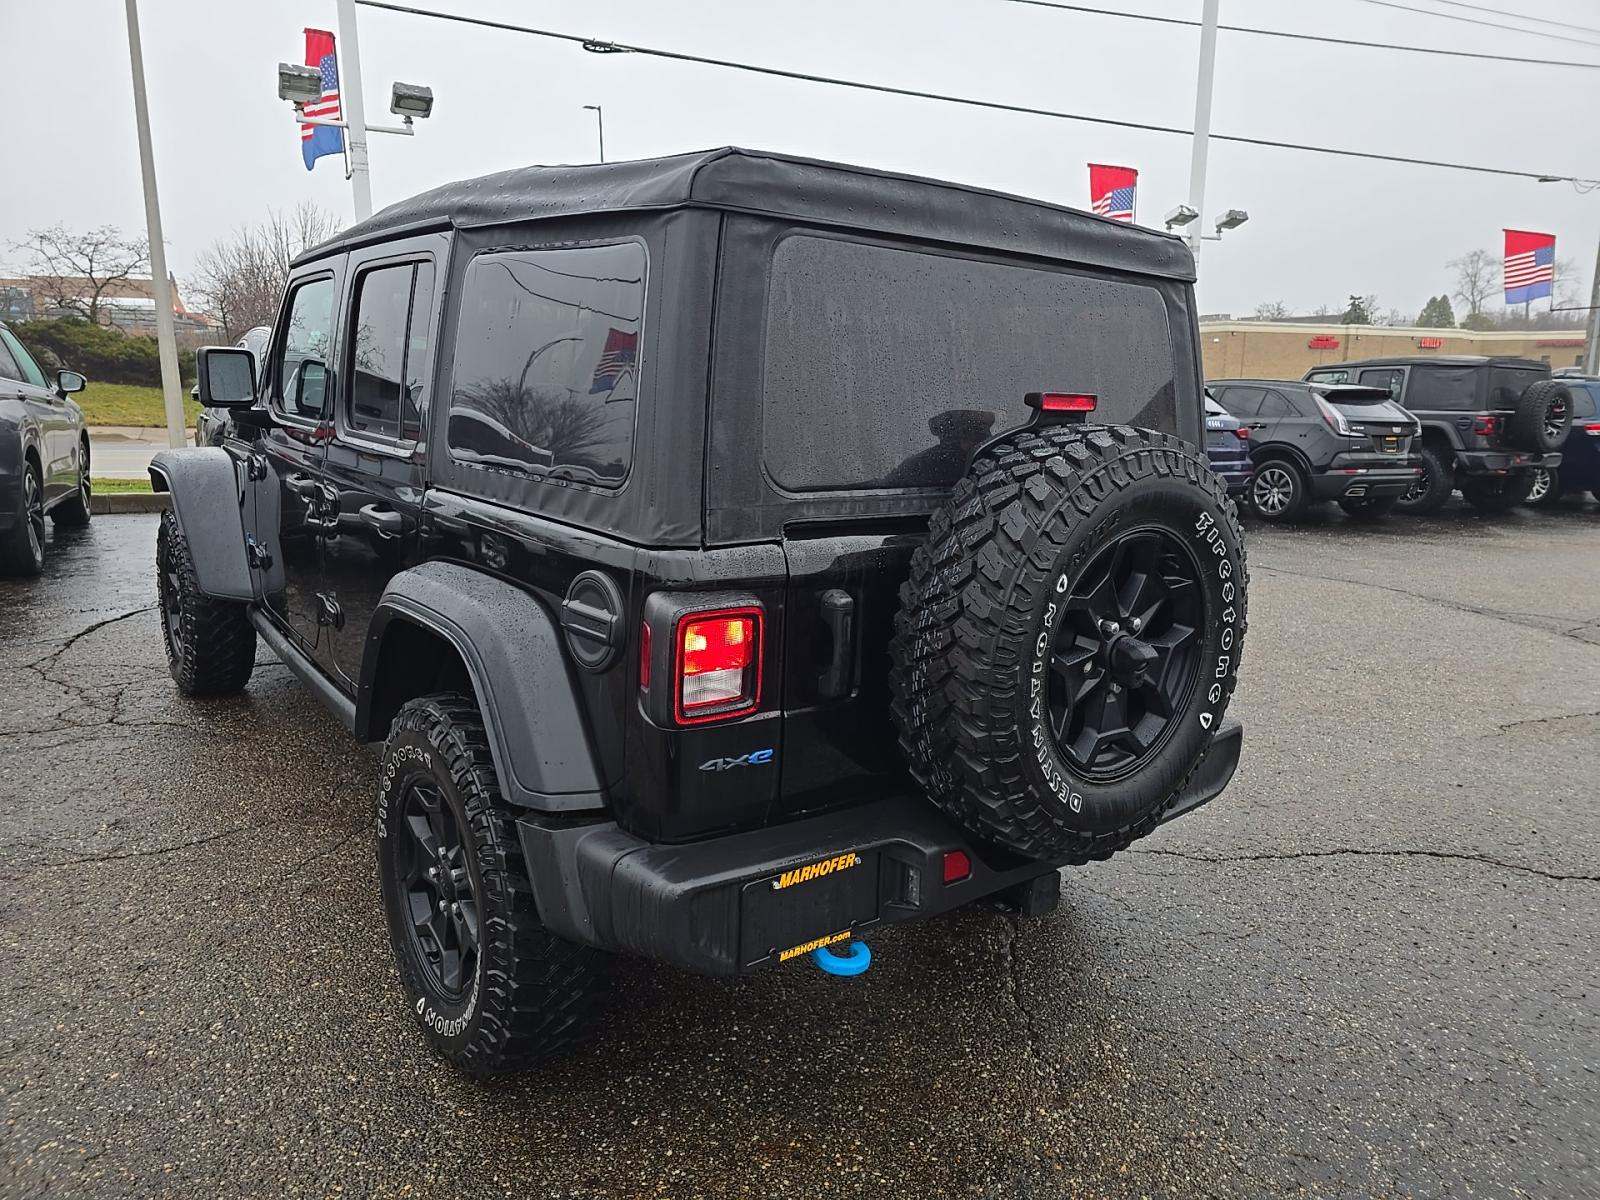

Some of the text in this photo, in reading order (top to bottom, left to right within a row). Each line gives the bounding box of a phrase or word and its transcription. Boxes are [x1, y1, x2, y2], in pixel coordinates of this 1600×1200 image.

[1194, 511, 1237, 705] Firestone
[1029, 603, 1083, 813] DESTINATION
[779, 853, 856, 889] MARHOFER
[779, 931, 851, 962] MARHOFER.com
